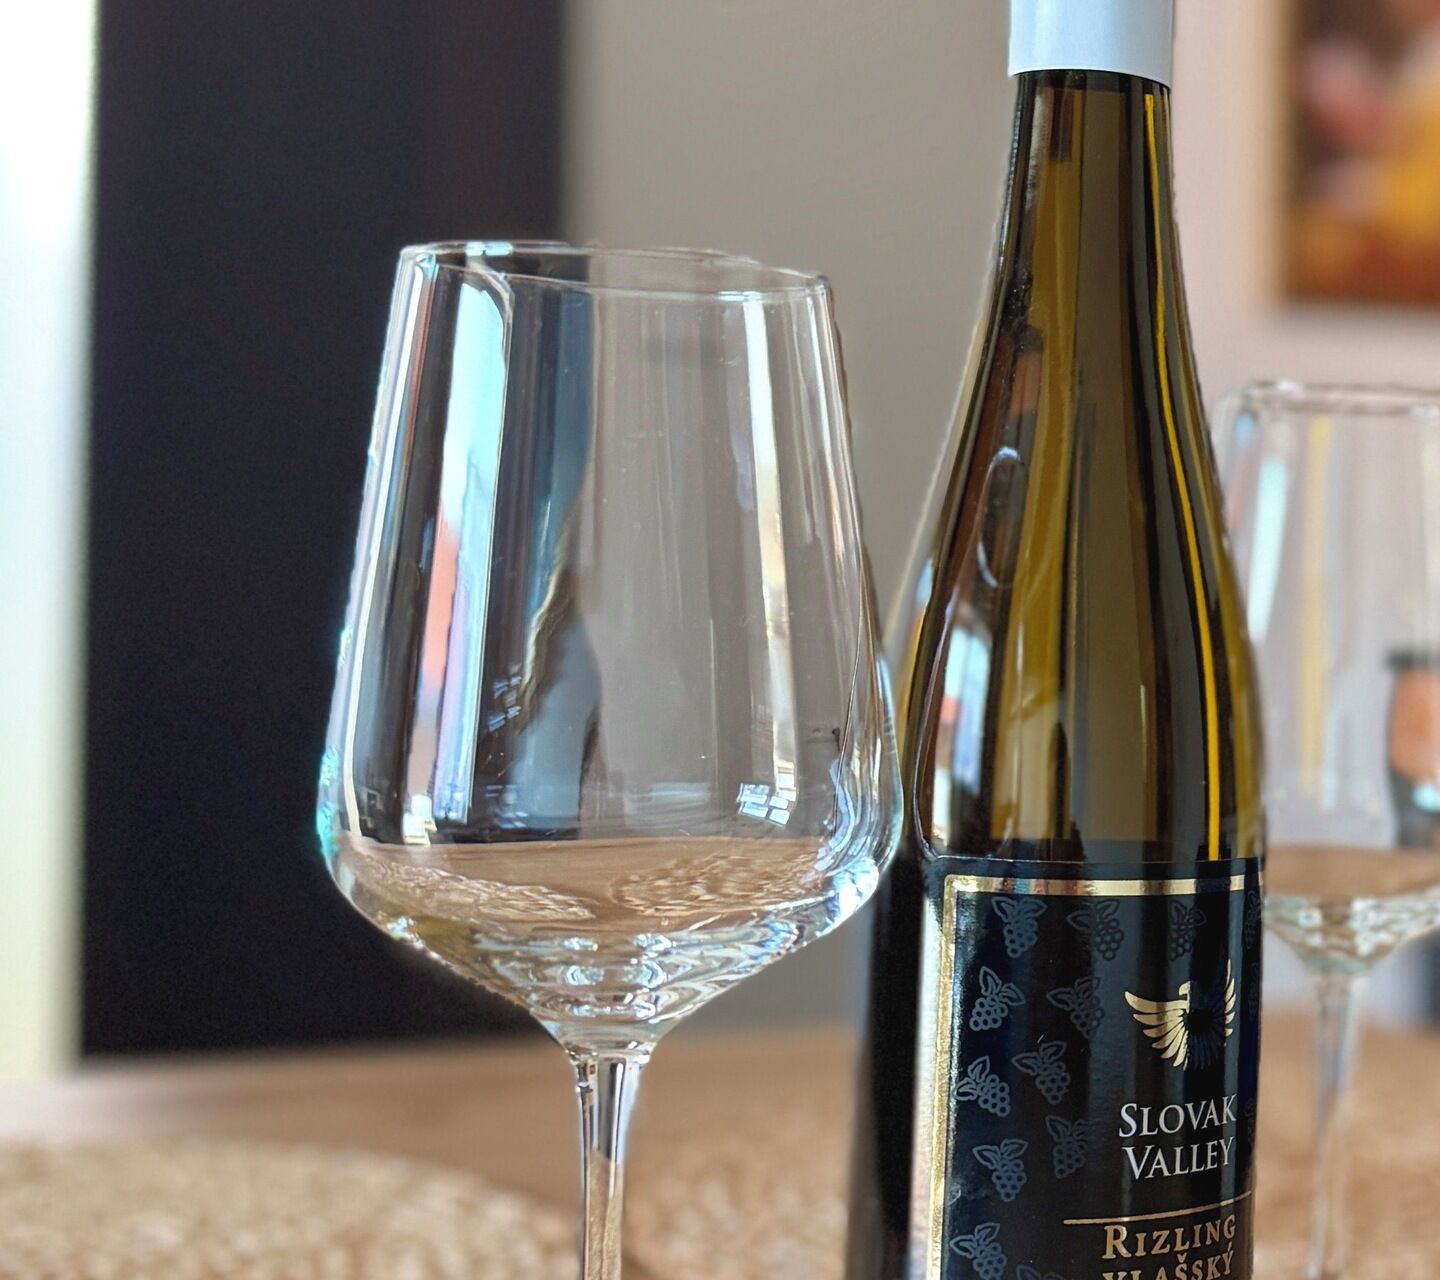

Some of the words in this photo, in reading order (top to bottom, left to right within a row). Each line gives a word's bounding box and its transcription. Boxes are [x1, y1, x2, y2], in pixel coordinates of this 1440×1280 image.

[1118, 1094, 1238, 1137] SLOVAK
[1121, 1136, 1235, 1180] VALLEY
[1102, 1214, 1236, 1259] RIZLING
